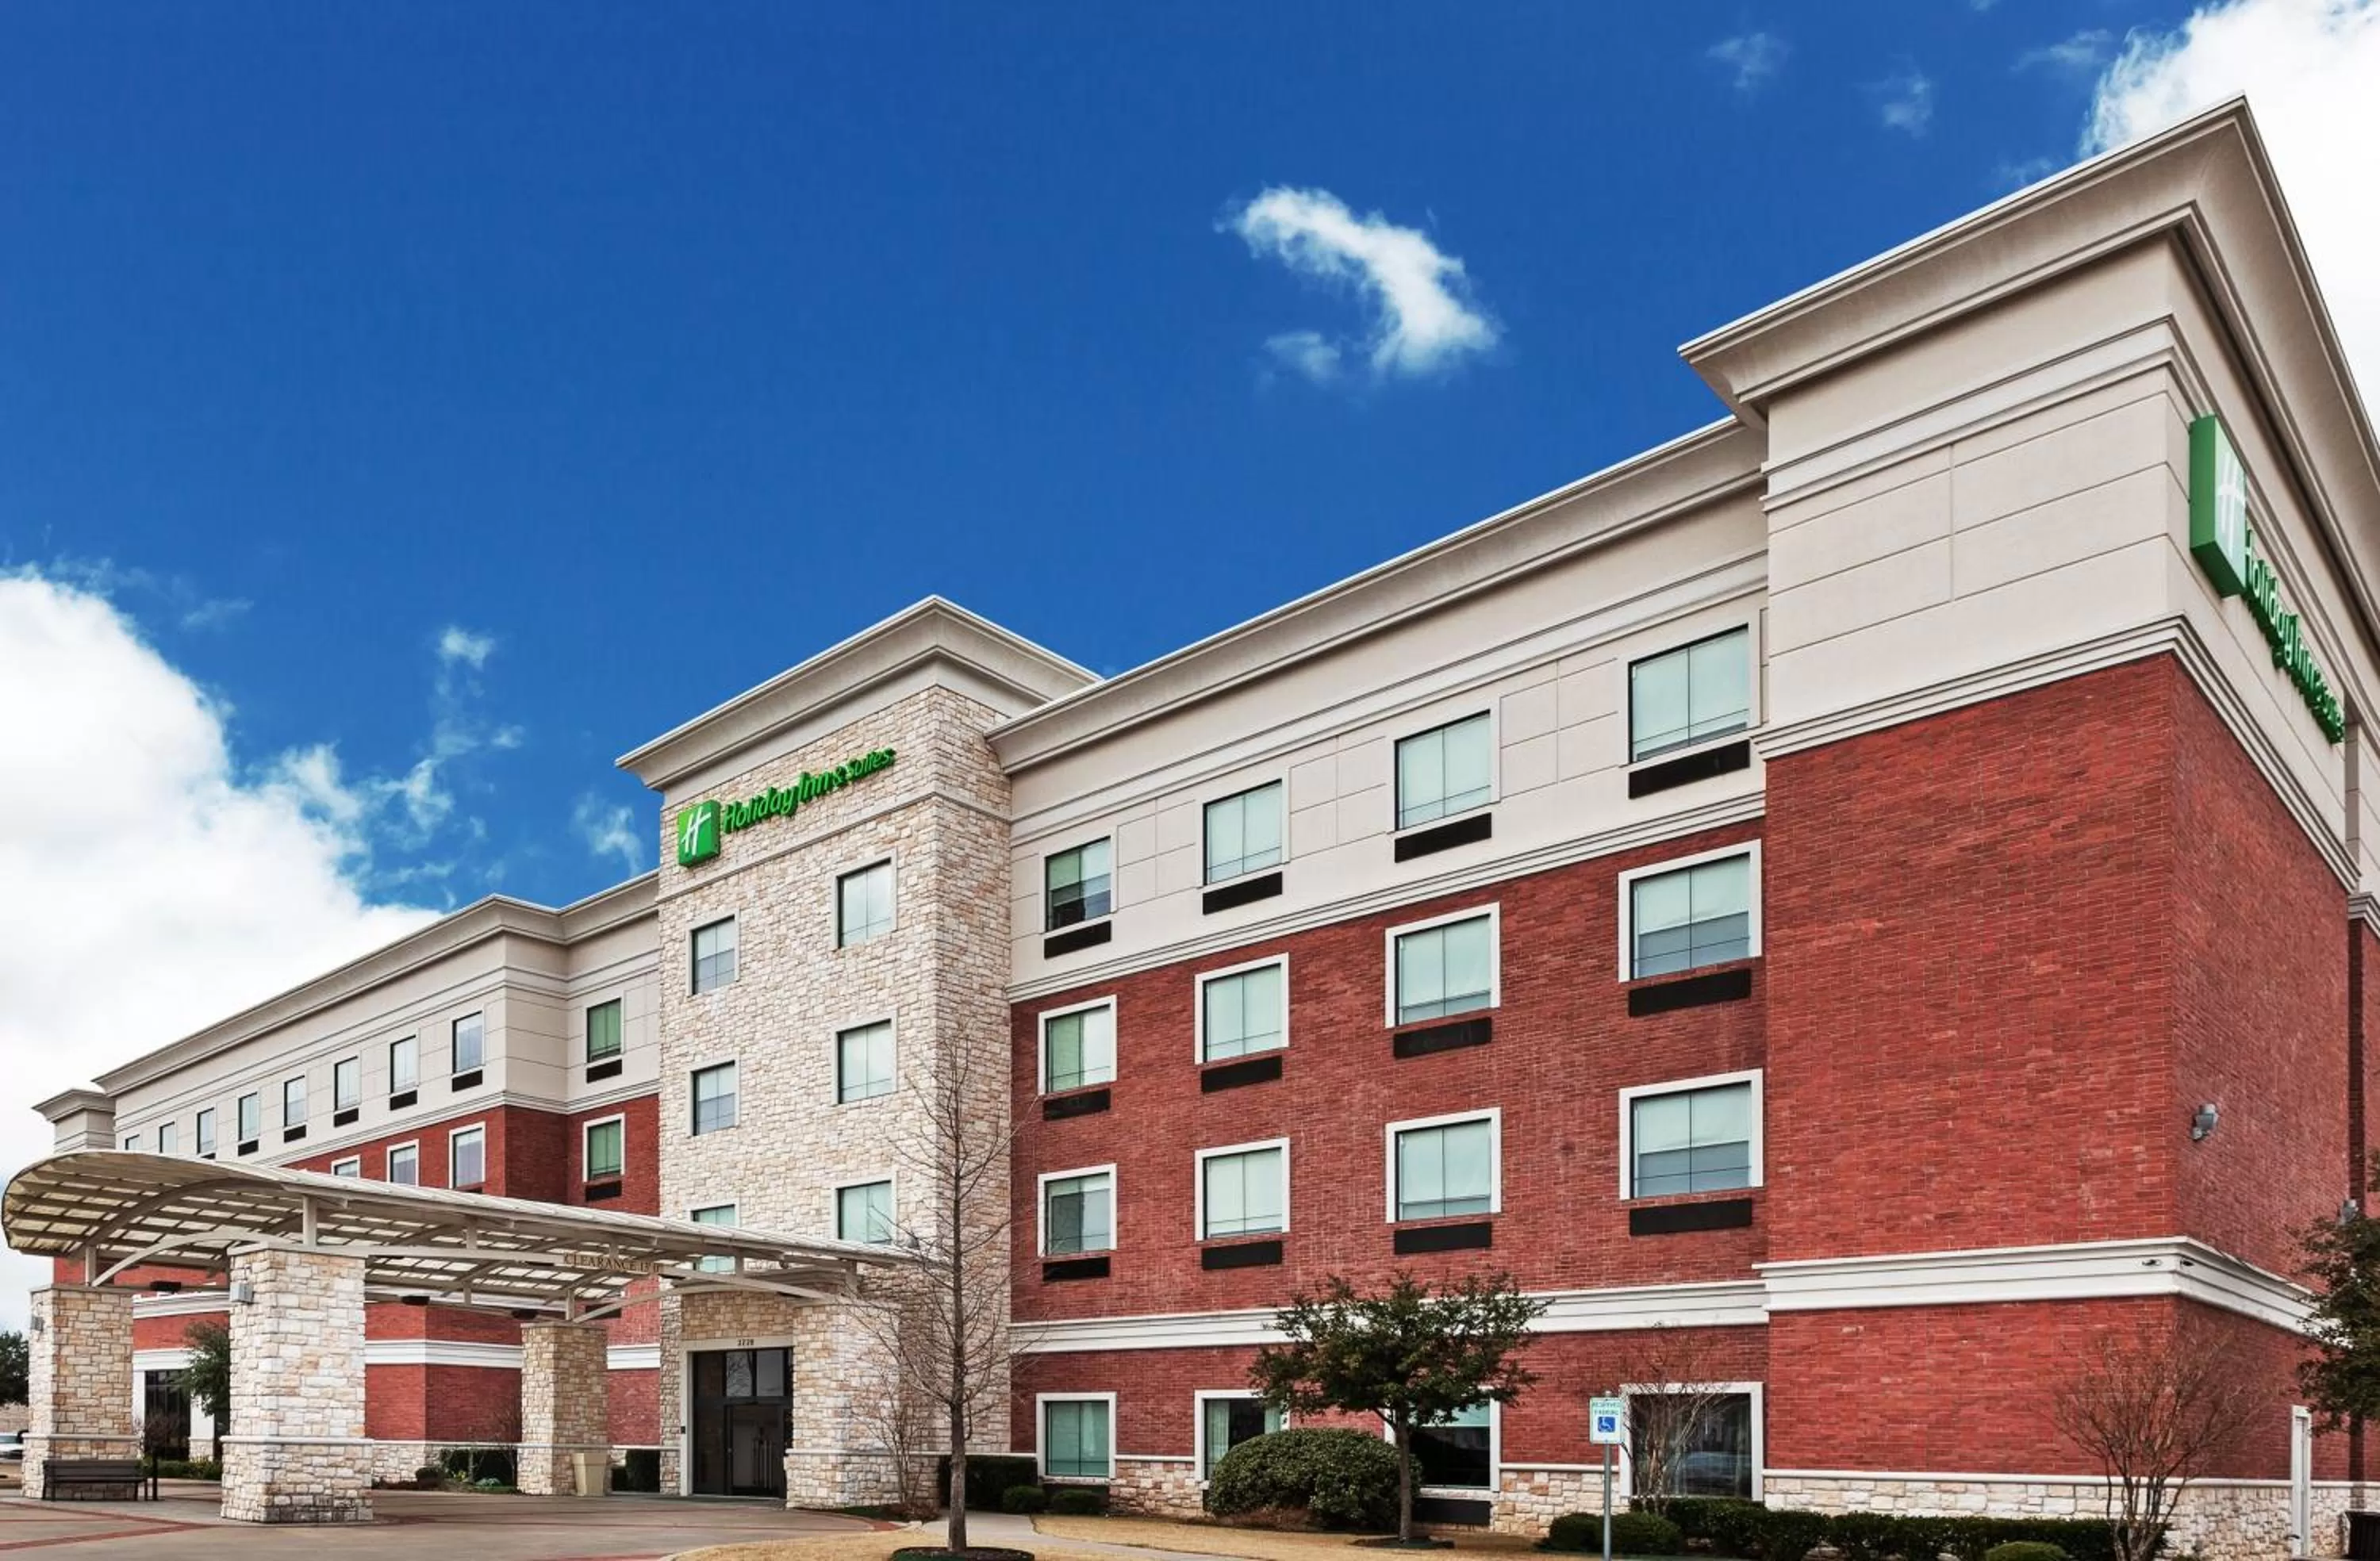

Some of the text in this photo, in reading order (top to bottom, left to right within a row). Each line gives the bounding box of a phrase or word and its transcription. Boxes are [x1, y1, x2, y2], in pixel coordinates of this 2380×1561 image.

[723, 786, 798, 834] Holiday
[797, 771, 835, 803] Inn
[832, 765, 849, 788] &
[563, 1252, 637, 1271] CLEARANCE
